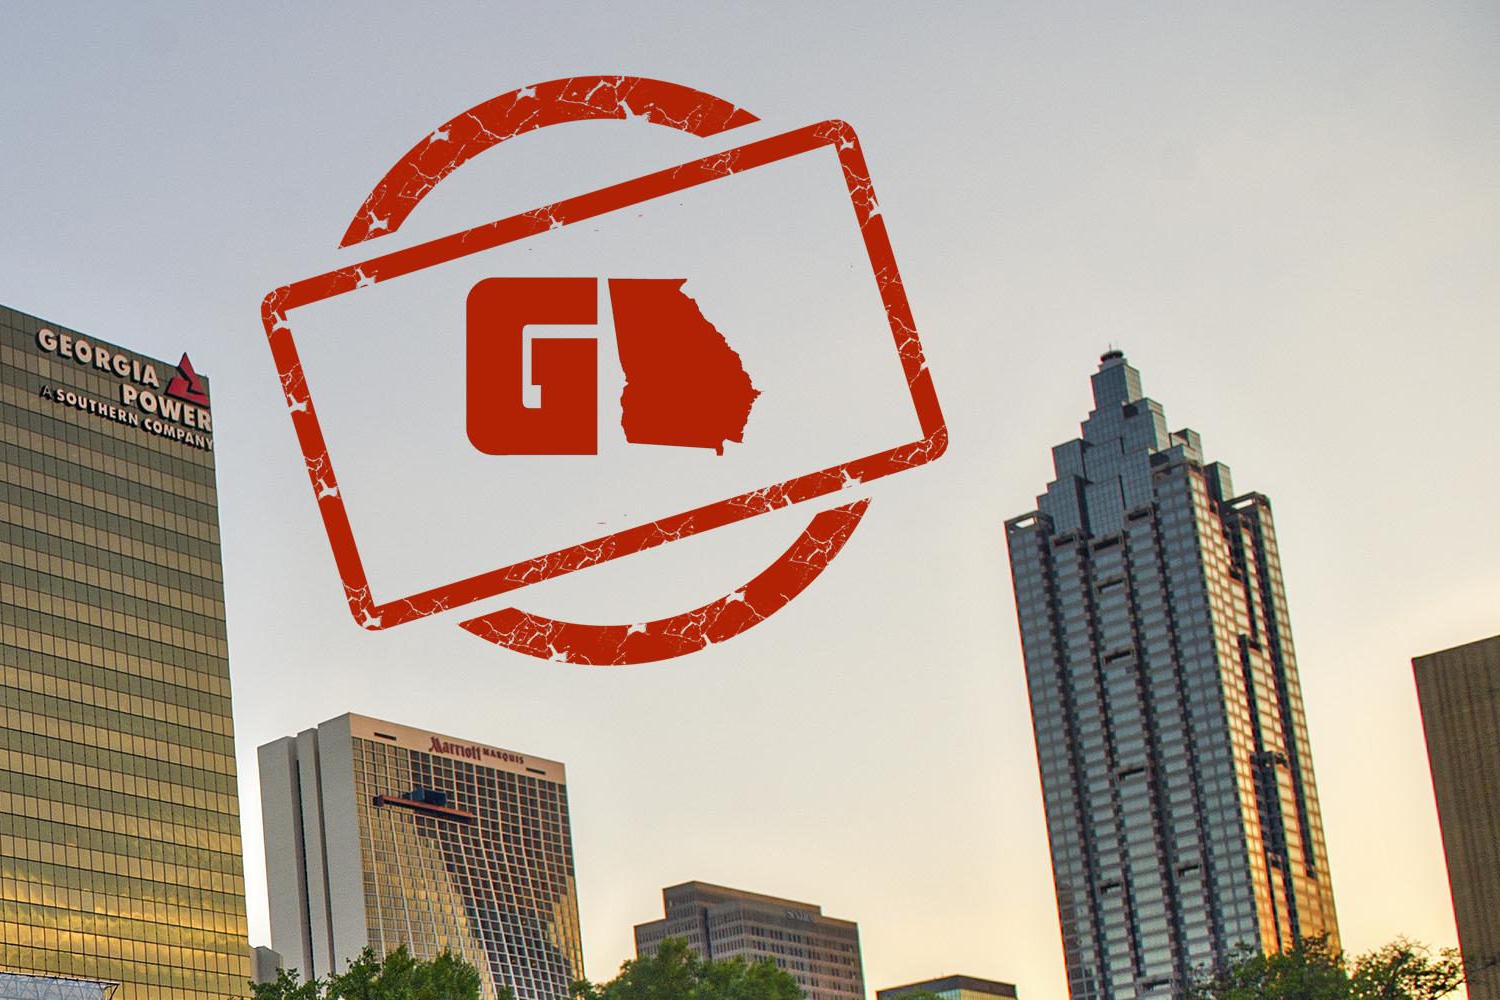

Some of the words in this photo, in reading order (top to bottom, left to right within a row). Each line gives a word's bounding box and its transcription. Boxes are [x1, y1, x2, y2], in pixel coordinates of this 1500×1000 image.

[37, 328, 159, 388] GEORGIA
[41, 384, 52, 398] A
[56, 388, 139, 426] SOUTHERN
[142, 417, 213, 451] COMPANY
[121, 383, 212, 432] POWER
[428, 736, 483, 761] Marriott
[482, 747, 525, 764] MARQUIS
